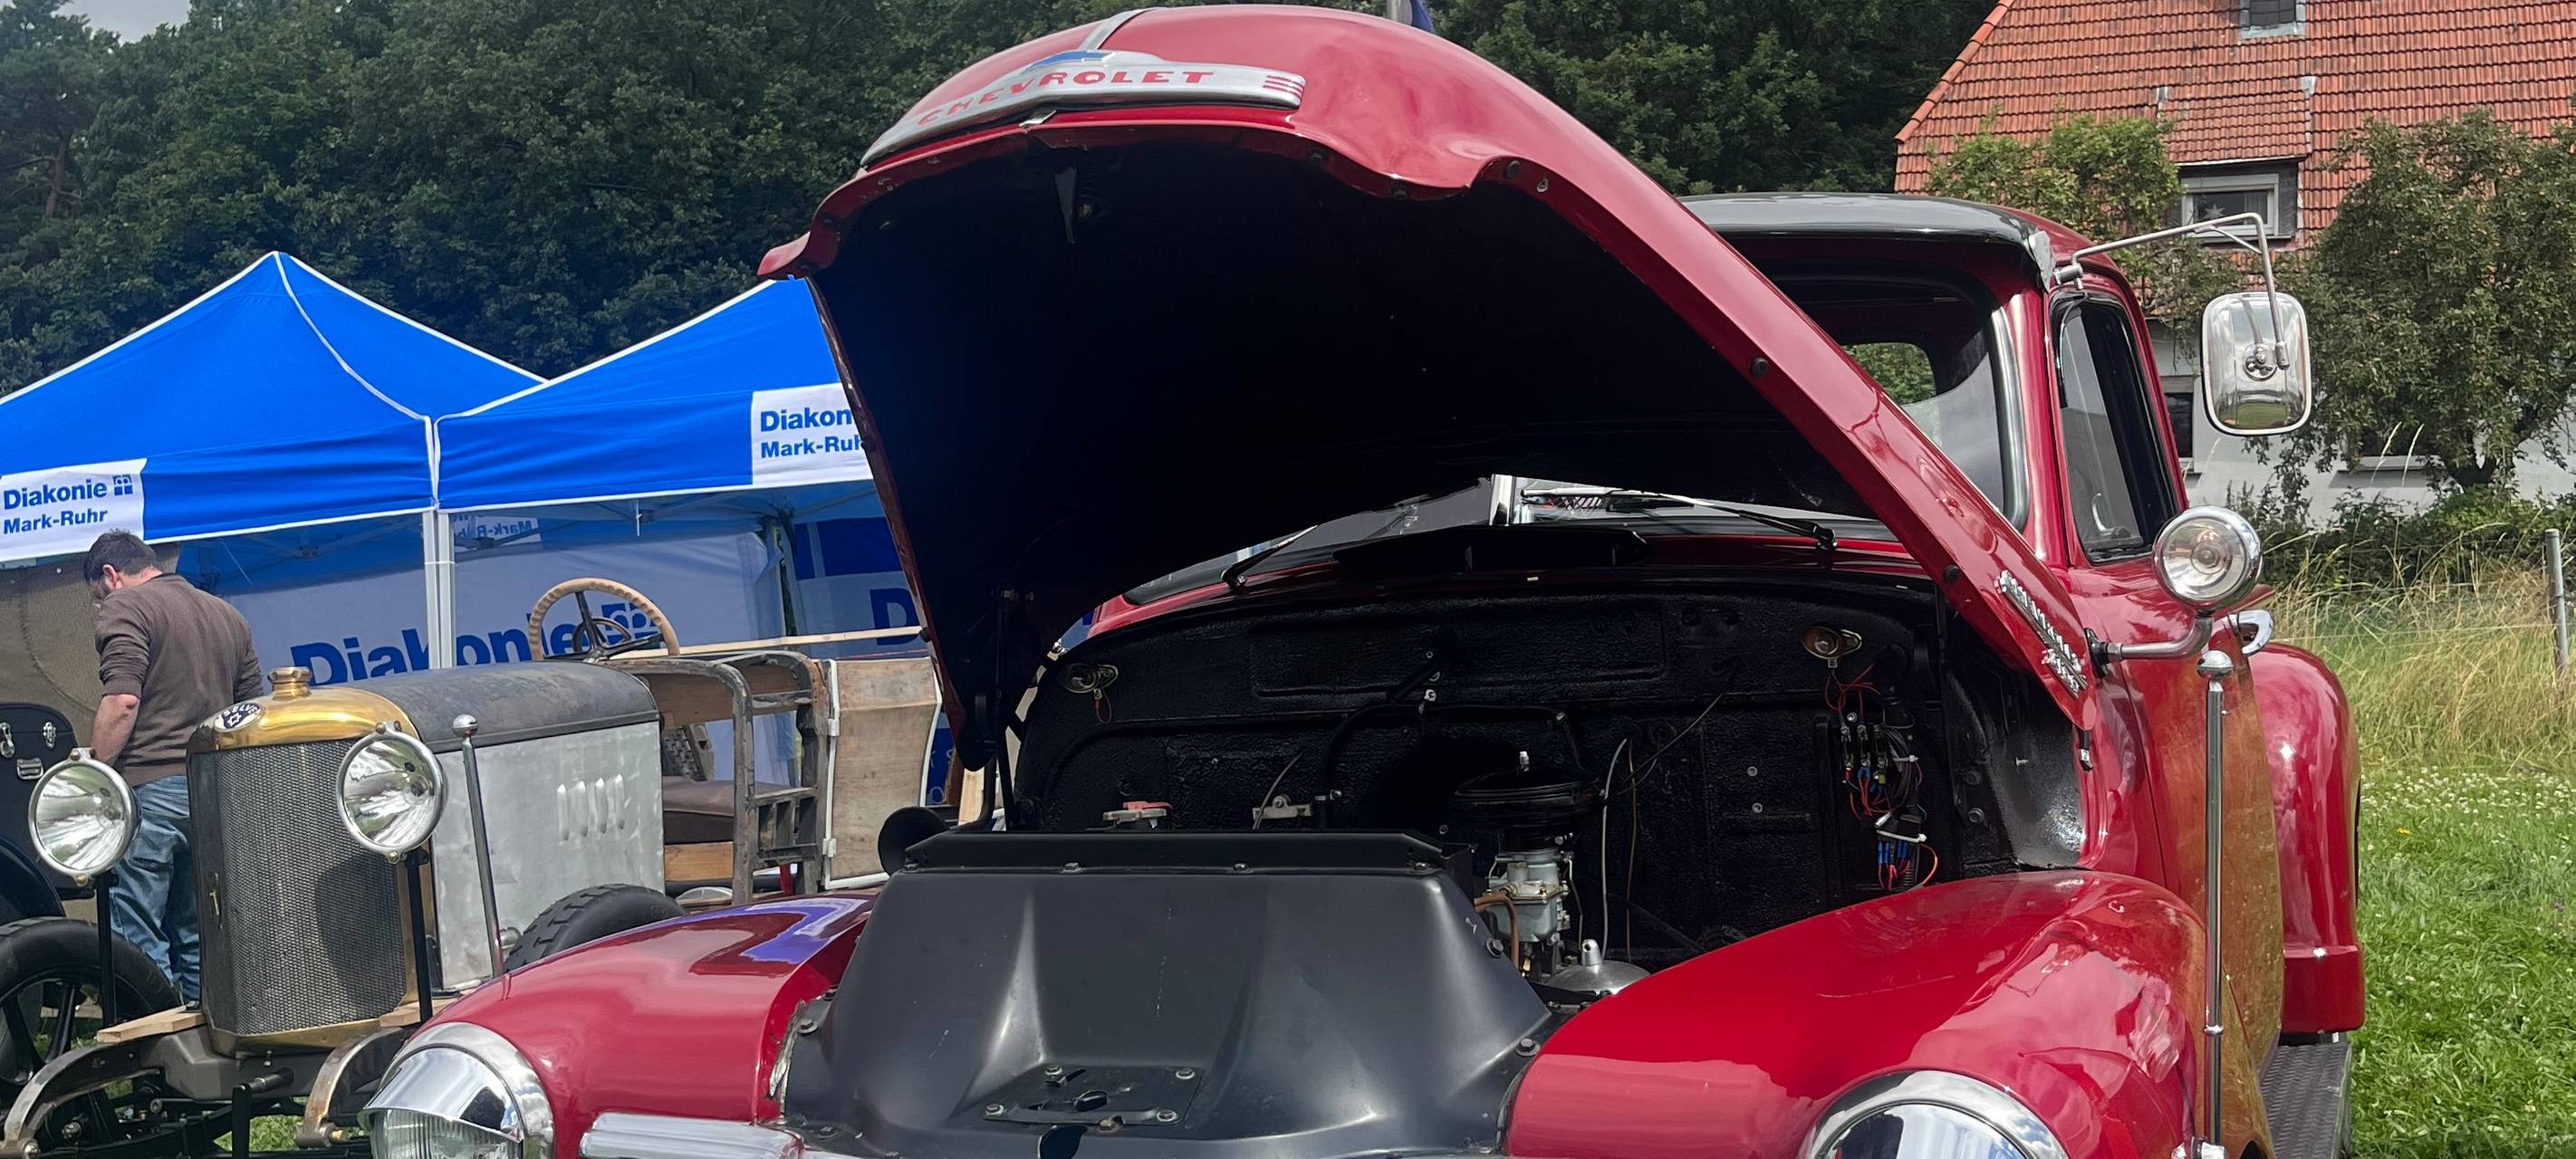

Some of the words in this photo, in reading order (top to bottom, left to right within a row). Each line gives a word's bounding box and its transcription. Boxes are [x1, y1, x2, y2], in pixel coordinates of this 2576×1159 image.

[918, 71, 1215, 127] CHEVROLET
[761, 407, 854, 432] Diakon
[4, 478, 108, 510] Diakonie
[4, 508, 108, 534] Mark-Ruhr
